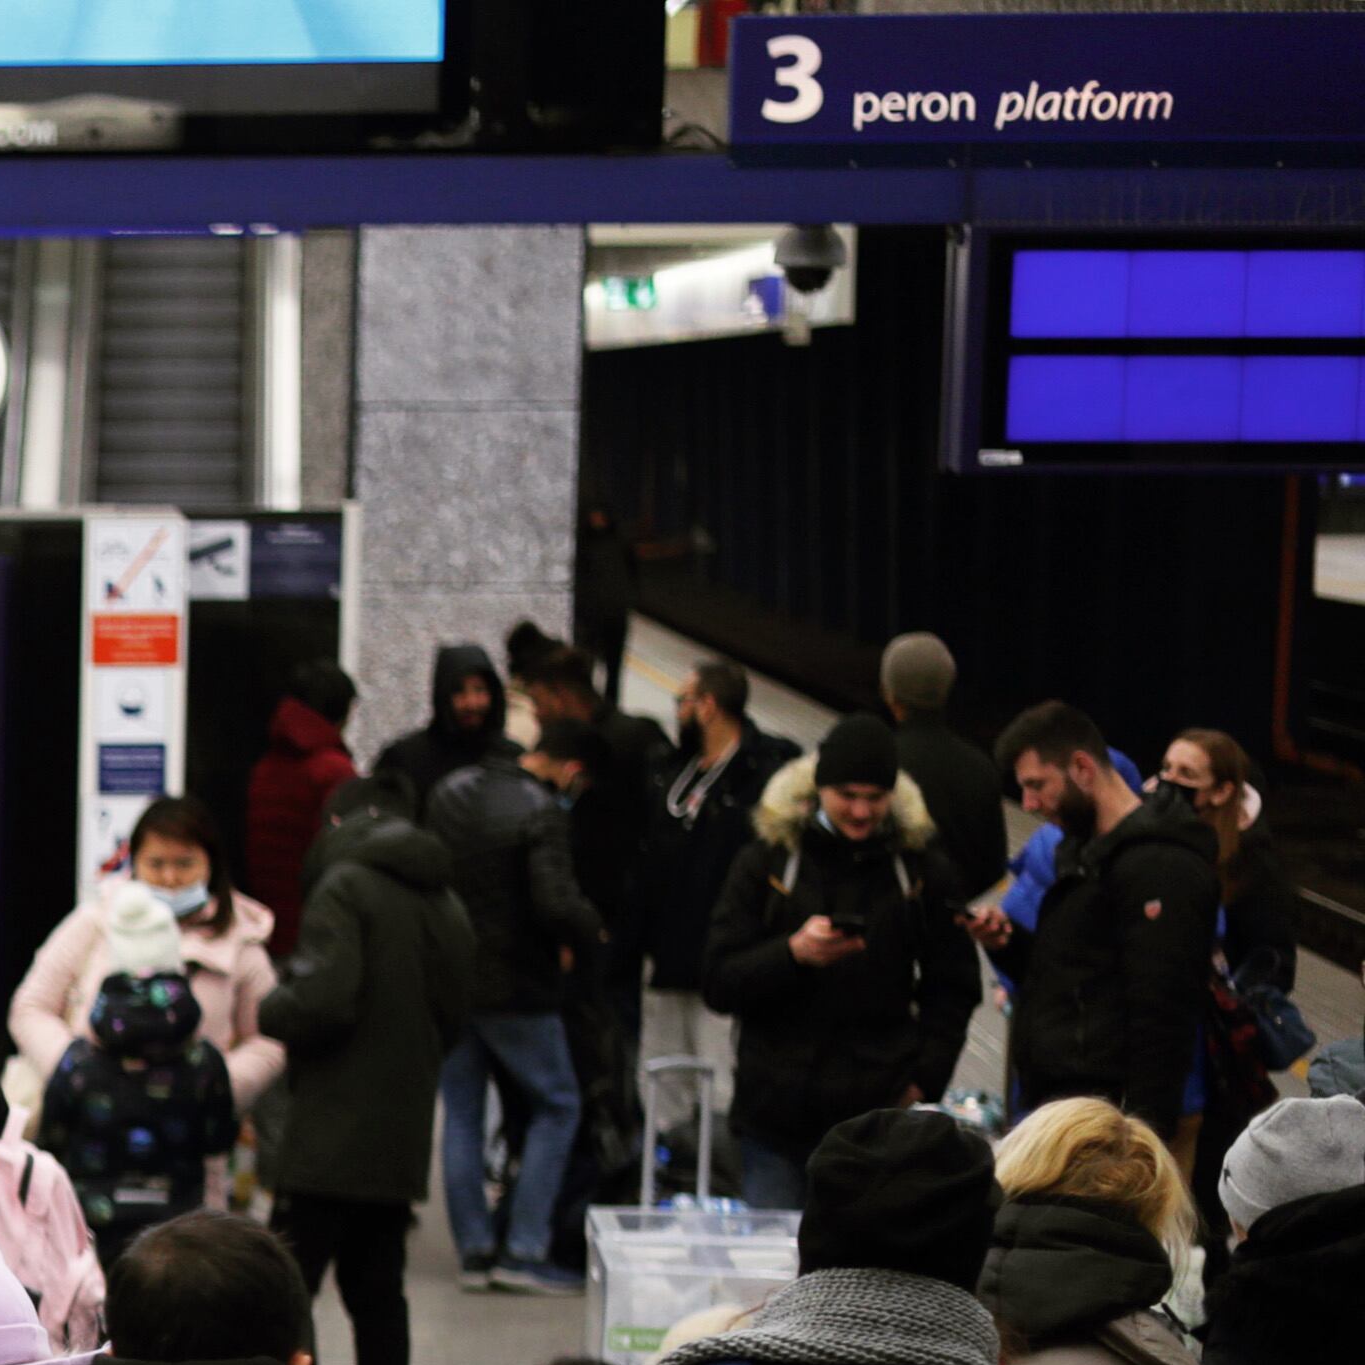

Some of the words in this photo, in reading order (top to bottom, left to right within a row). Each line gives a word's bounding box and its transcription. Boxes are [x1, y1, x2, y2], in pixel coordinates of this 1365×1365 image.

[761, 34, 824, 123] 3
[852, 91, 977, 131] peron
[995, 79, 1174, 131] platform
